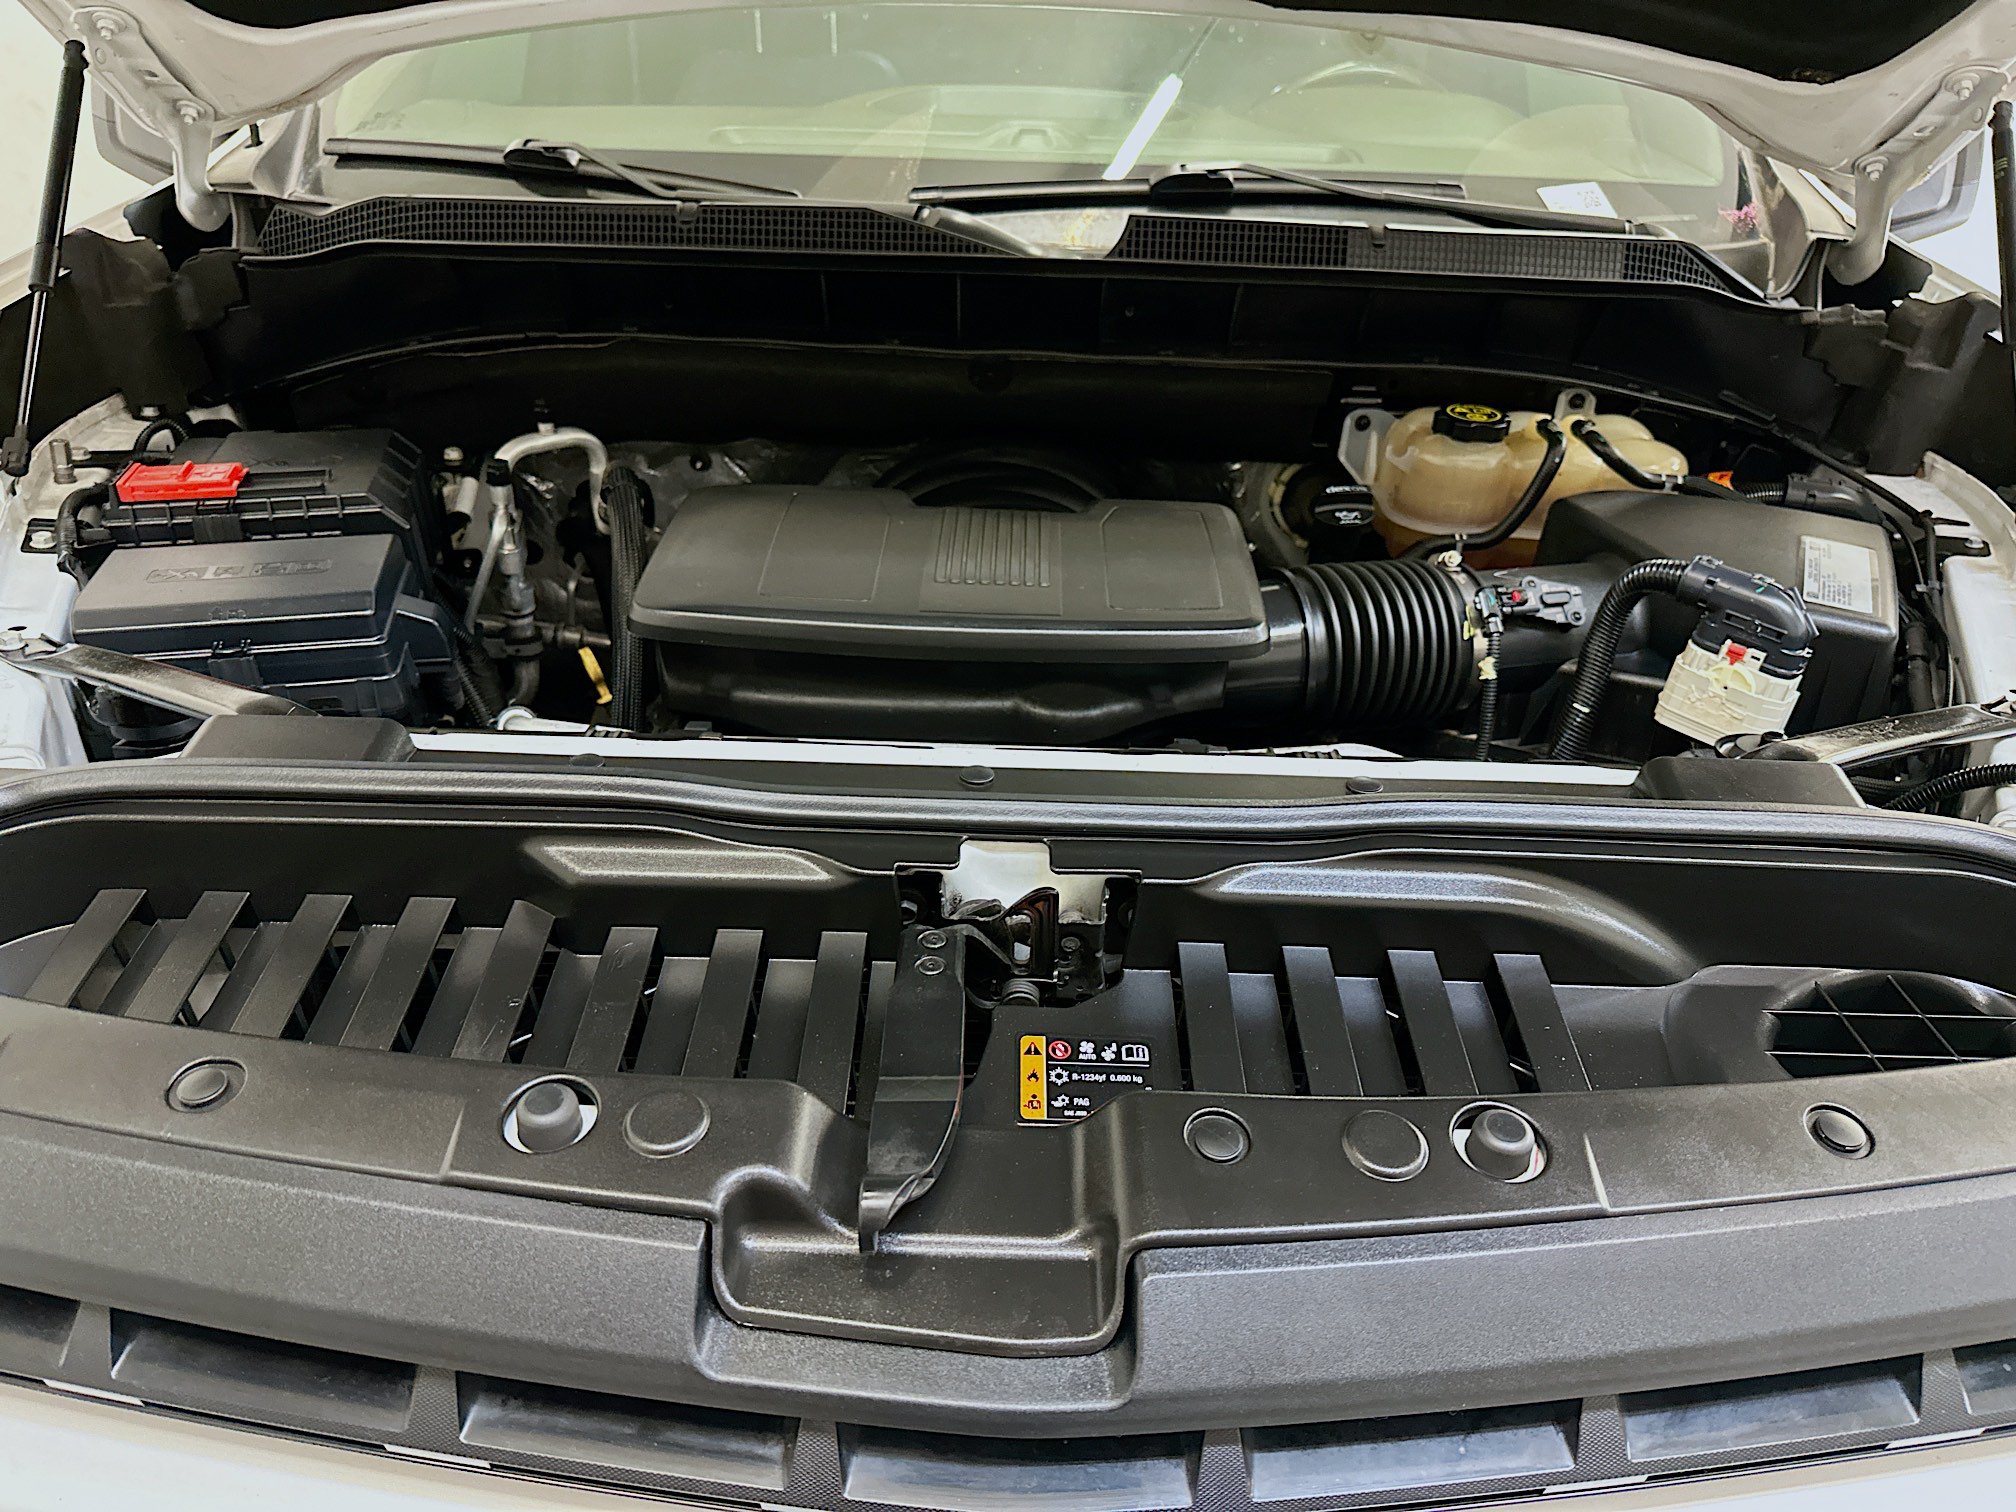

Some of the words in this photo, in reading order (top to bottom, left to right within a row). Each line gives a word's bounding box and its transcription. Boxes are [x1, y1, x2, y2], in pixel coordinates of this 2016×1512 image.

[1072, 1073, 1106, 1082] R-1234yf
[1133, 1075, 1143, 1083] kg
[1073, 1098, 1090, 1106] PAG
